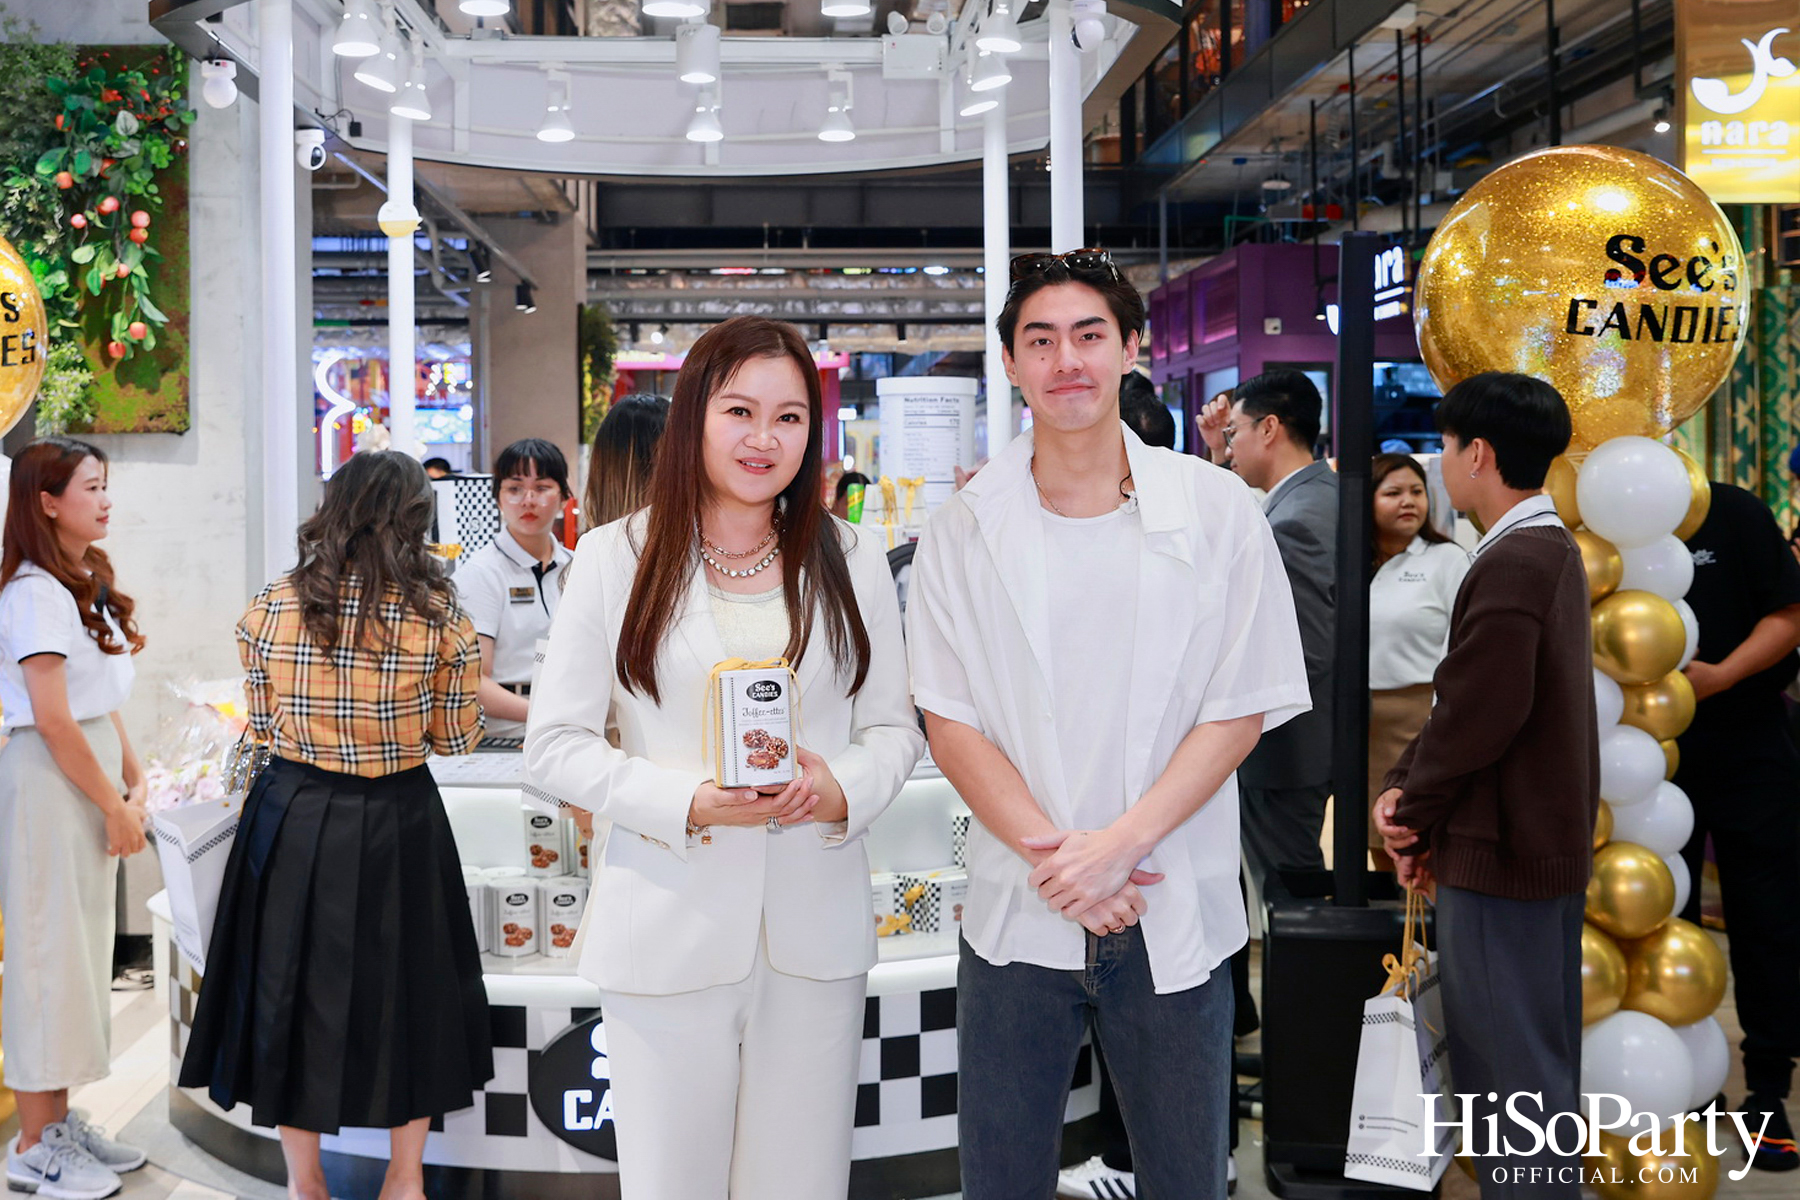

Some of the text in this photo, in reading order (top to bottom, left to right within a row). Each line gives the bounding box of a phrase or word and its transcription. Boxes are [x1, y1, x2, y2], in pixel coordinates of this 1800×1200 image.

[1701, 120, 1789, 146] nara
[1604, 234, 1738, 292] See's
[754, 683, 776, 692] See's
[563, 1088, 614, 1130] CA
